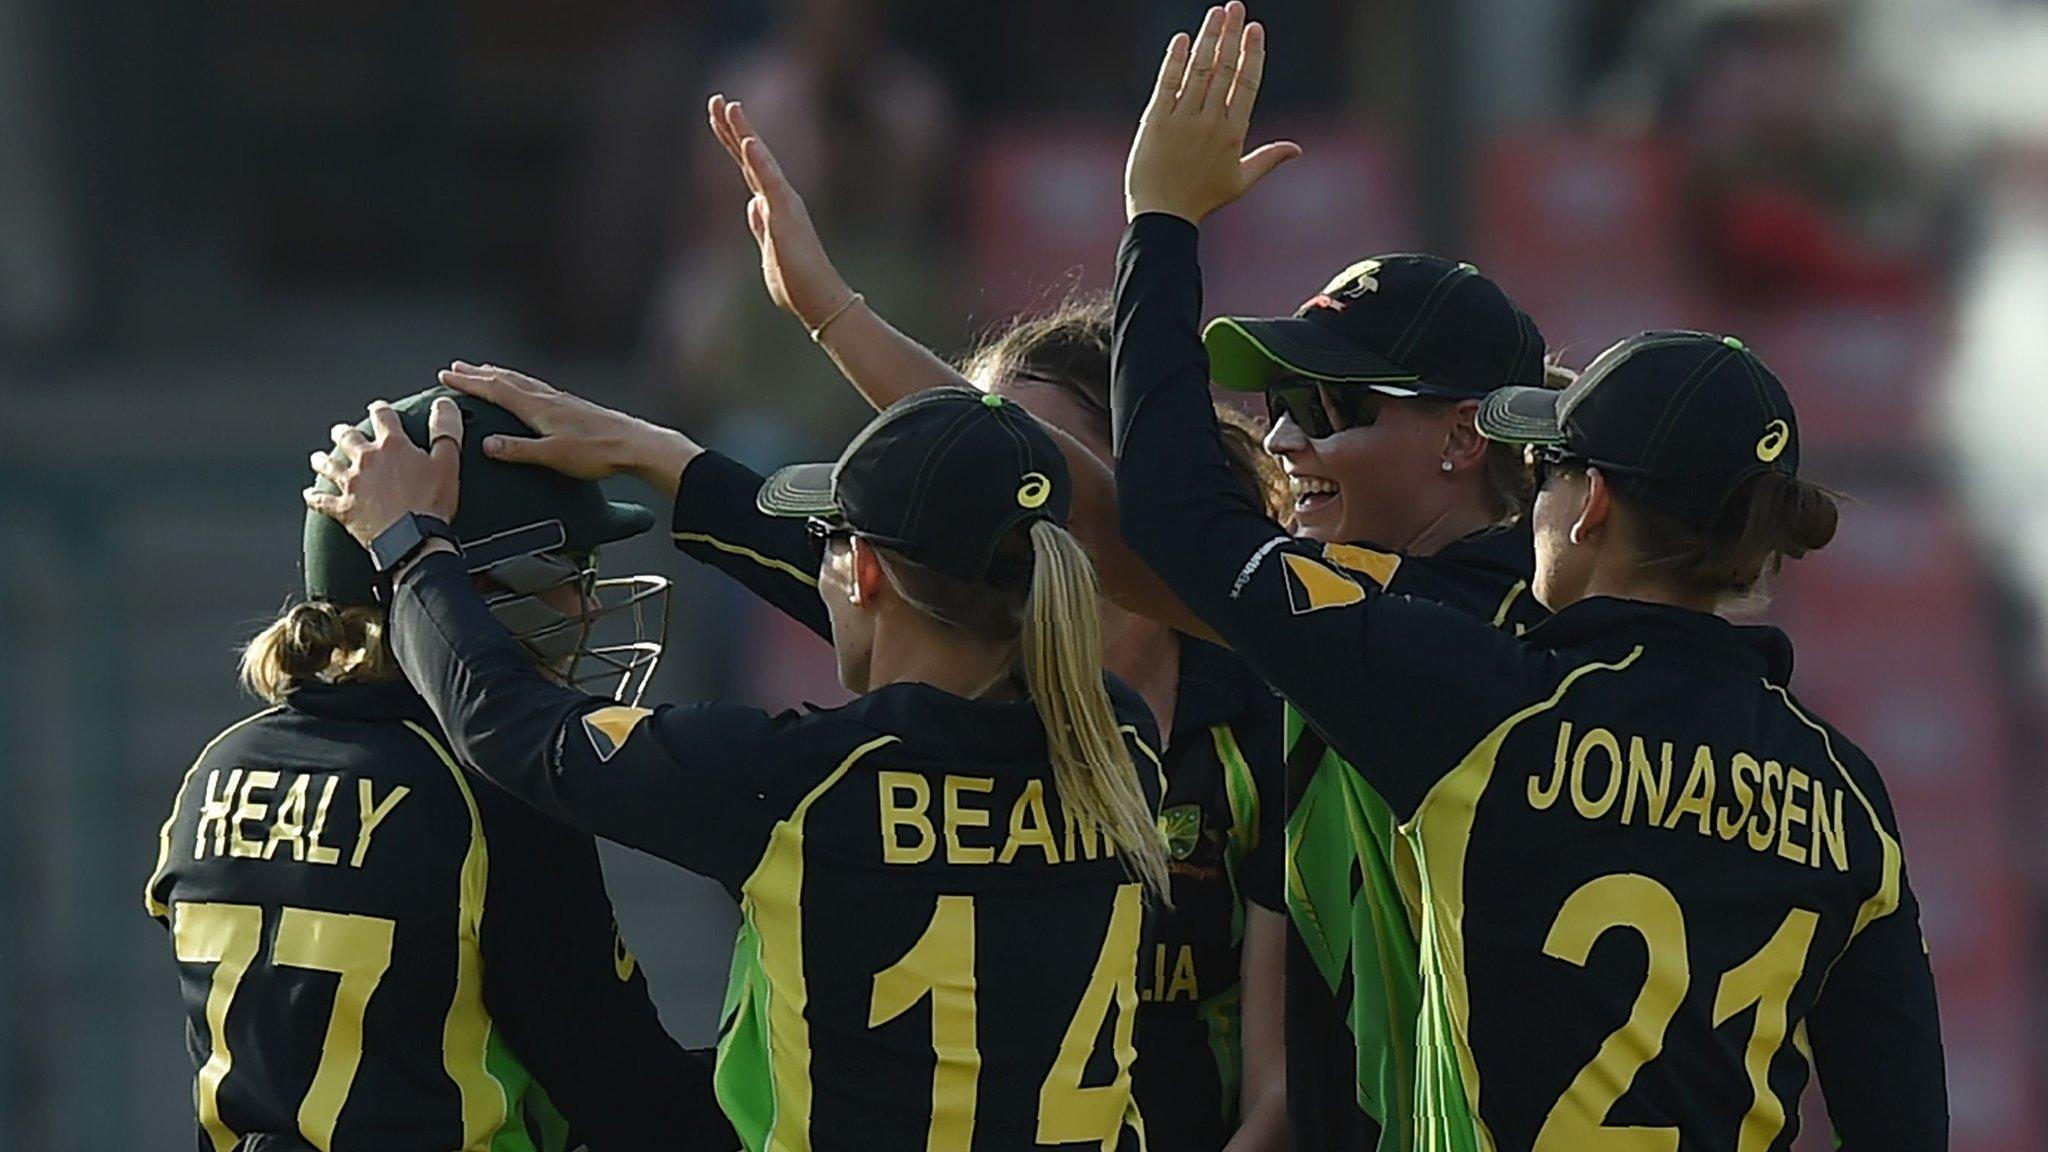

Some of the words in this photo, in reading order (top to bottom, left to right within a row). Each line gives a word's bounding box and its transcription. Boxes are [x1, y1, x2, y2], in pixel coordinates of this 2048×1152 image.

[194, 768, 410, 868] HEALY
[1527, 721, 1849, 871] JONASSEN
[174, 901, 396, 1152] 77
[868, 883, 1143, 1152] 14
[1141, 943, 1199, 1001] IA
[1532, 872, 1820, 1152] 21
